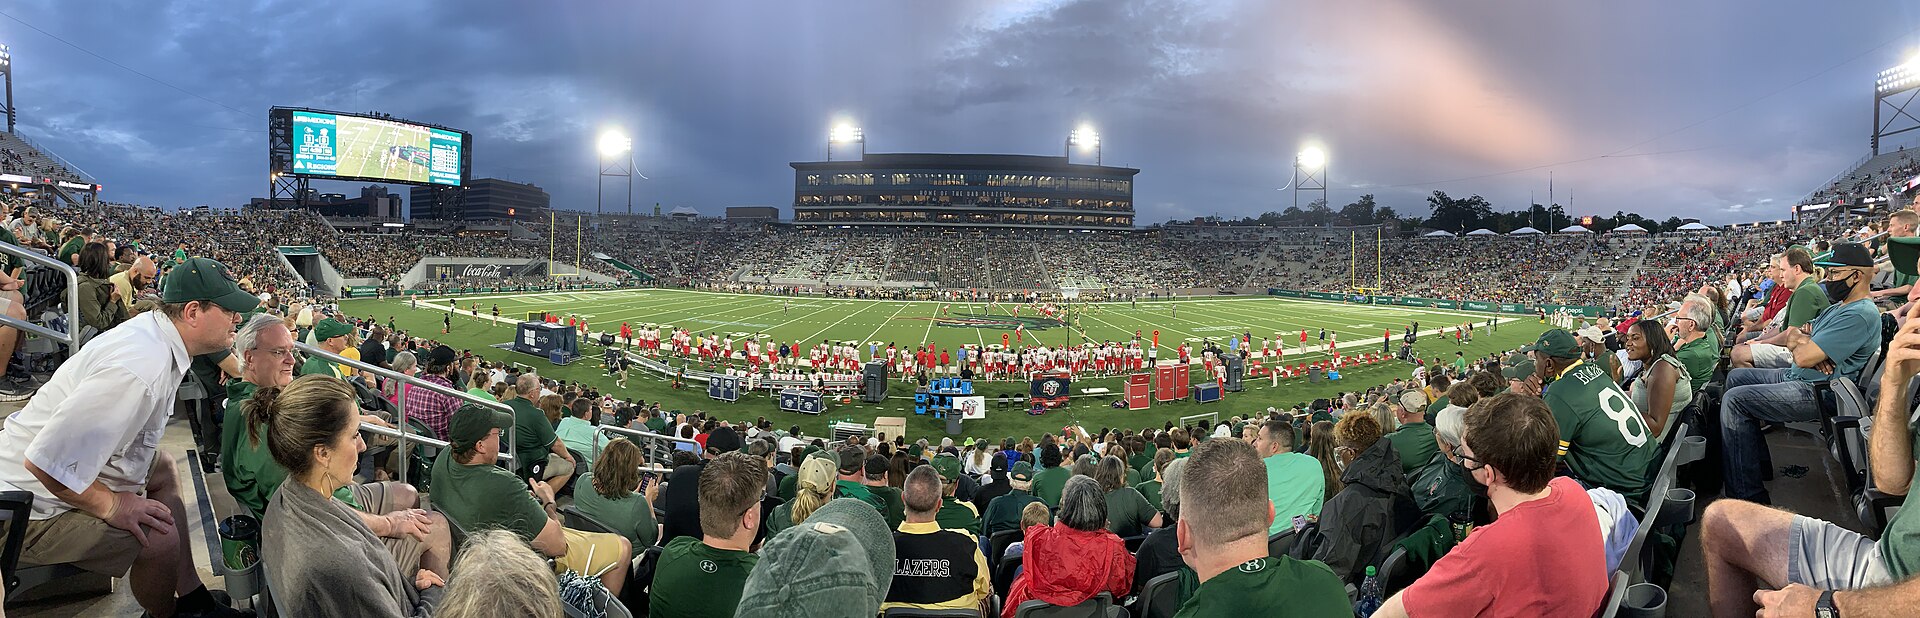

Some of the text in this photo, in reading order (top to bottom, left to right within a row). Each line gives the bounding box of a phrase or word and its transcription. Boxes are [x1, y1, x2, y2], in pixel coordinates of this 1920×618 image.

[463, 263, 502, 277] Coca-Cola
[1567, 307, 1584, 315] pepsi
[1598, 382, 1652, 448] 8
[895, 559, 951, 577] LAZERS
